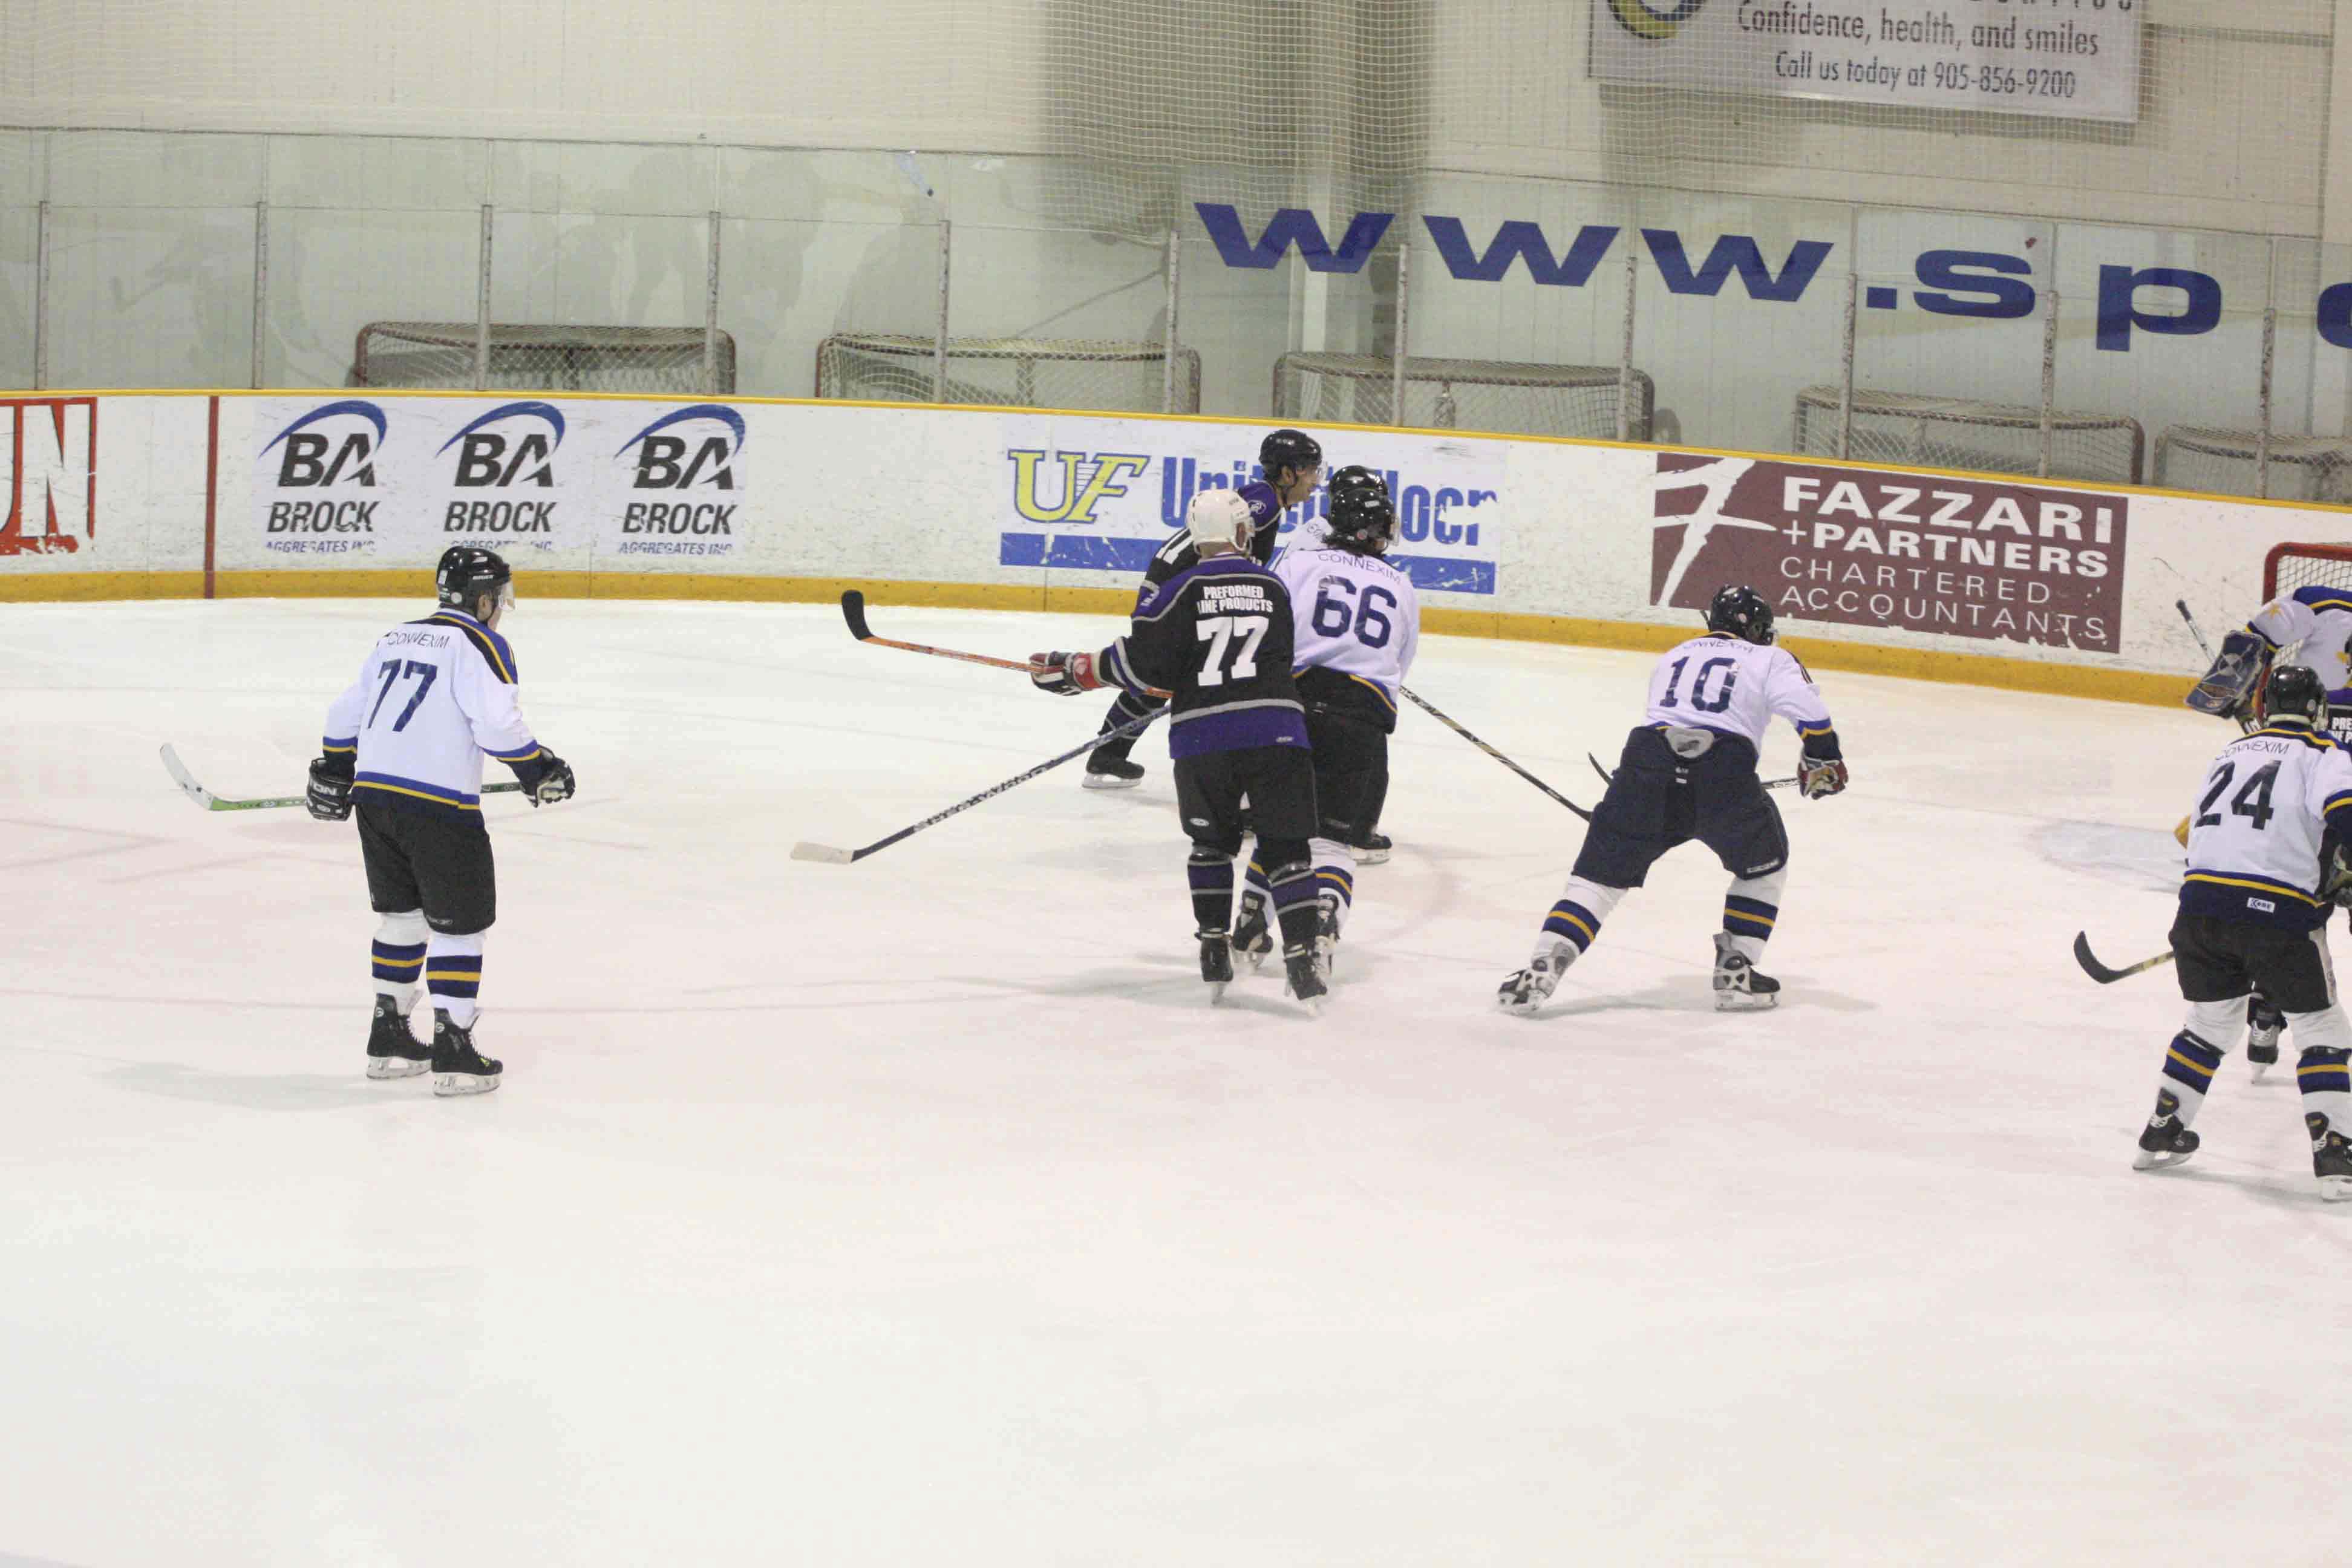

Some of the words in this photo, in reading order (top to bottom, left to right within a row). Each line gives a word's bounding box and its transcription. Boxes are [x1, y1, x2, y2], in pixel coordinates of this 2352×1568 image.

[1737, 0, 1871, 45] Confidence,
[1880, 8, 1960, 51] health,
[1971, 16, 2016, 50] and
[2025, 20, 2099, 56] smiles
[1776, 51, 1812, 79] Call
[1819, 62, 1839, 81] us
[1847, 56, 1901, 91] today
[1907, 60, 1927, 87] at
[1934, 61, 2076, 98] 905-856-9200
[277, 433, 377, 487] BA
[454, 433, 554, 488] BA
[632, 435, 734, 490] BA
[1008, 448, 1152, 524] UF
[266, 500, 381, 533] BROCK
[443, 501, 558, 533] BROCK
[621, 503, 739, 535] BROCK
[1783, 475, 2113, 544] FAZZARI
[1203, 584, 1264, 599] PREFORMED
[1318, 553, 1401, 585] CONNEXIM
[1780, 556, 2051, 604] CHARTERED
[1218, 596, 1273, 613] PRODUCTS
[1313, 575, 1397, 649] 66
[1780, 584, 2107, 640] ACCOUNTANTS
[1196, 615, 1269, 687] 77
[367, 658, 438, 732] 77
[1659, 656, 1740, 714] 10
[2194, 759, 2282, 831] 24
